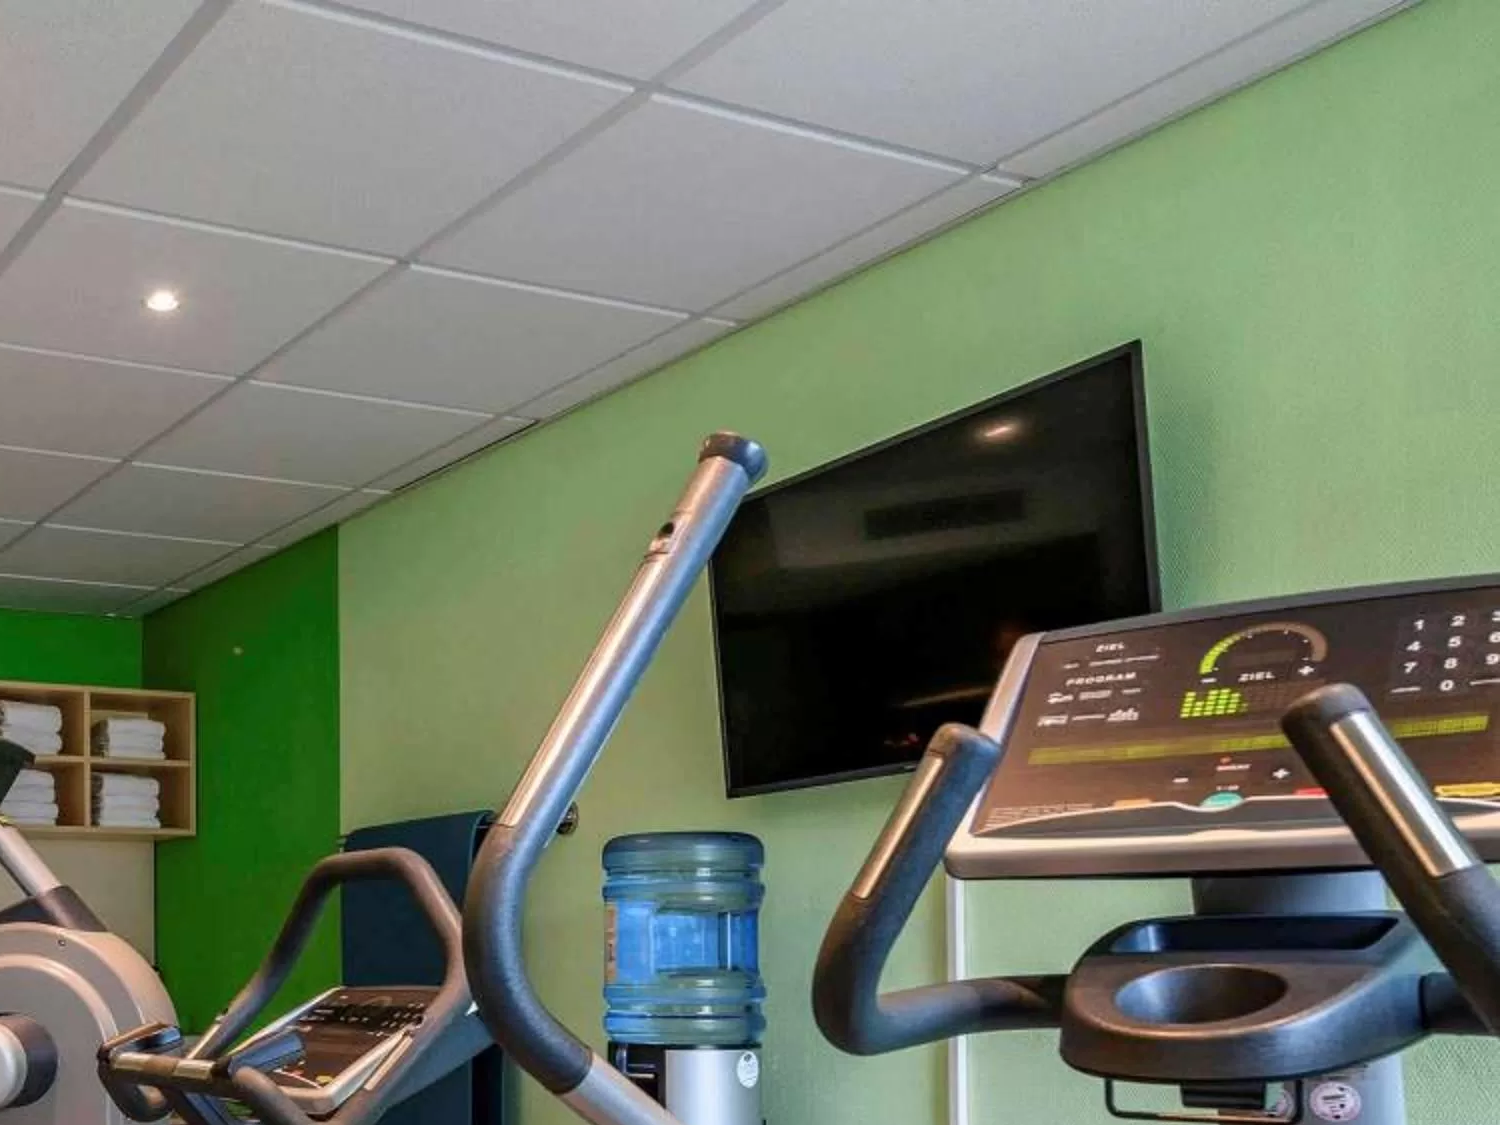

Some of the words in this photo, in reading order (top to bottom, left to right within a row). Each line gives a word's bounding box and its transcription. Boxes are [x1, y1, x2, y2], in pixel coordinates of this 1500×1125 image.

[1413, 619, 1424, 630] 1
[1450, 615, 1466, 627] 2
[1403, 661, 1418, 674] 7
[1065, 671, 1137, 687] PROGRAM
[1238, 671, 1275, 683] ZIEL
[1440, 679, 1454, 691] 0
